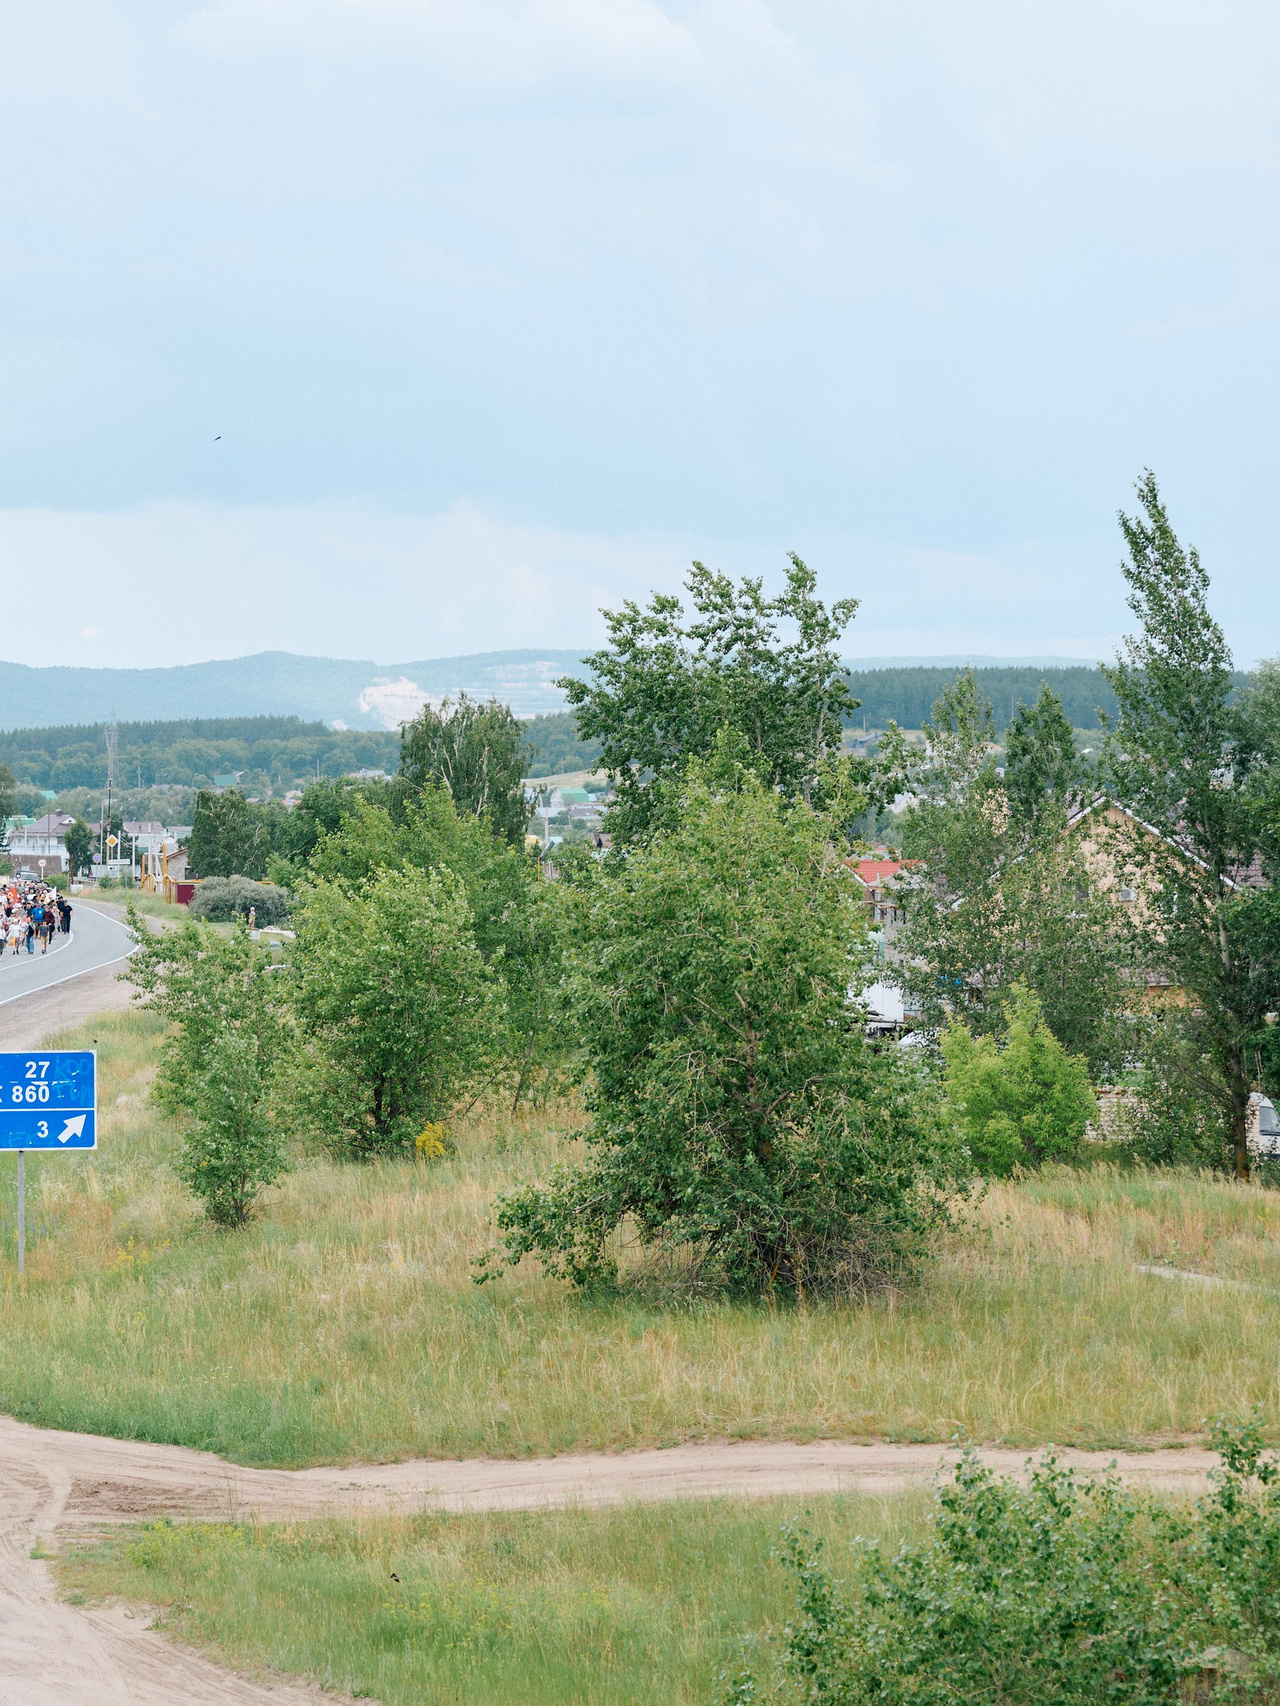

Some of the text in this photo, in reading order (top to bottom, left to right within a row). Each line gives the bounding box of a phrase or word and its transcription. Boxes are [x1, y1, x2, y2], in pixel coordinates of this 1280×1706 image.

[25, 1061, 50, 1079] 27
[11, 1084, 50, 1103] 860
[37, 1120, 49, 1138] 3
